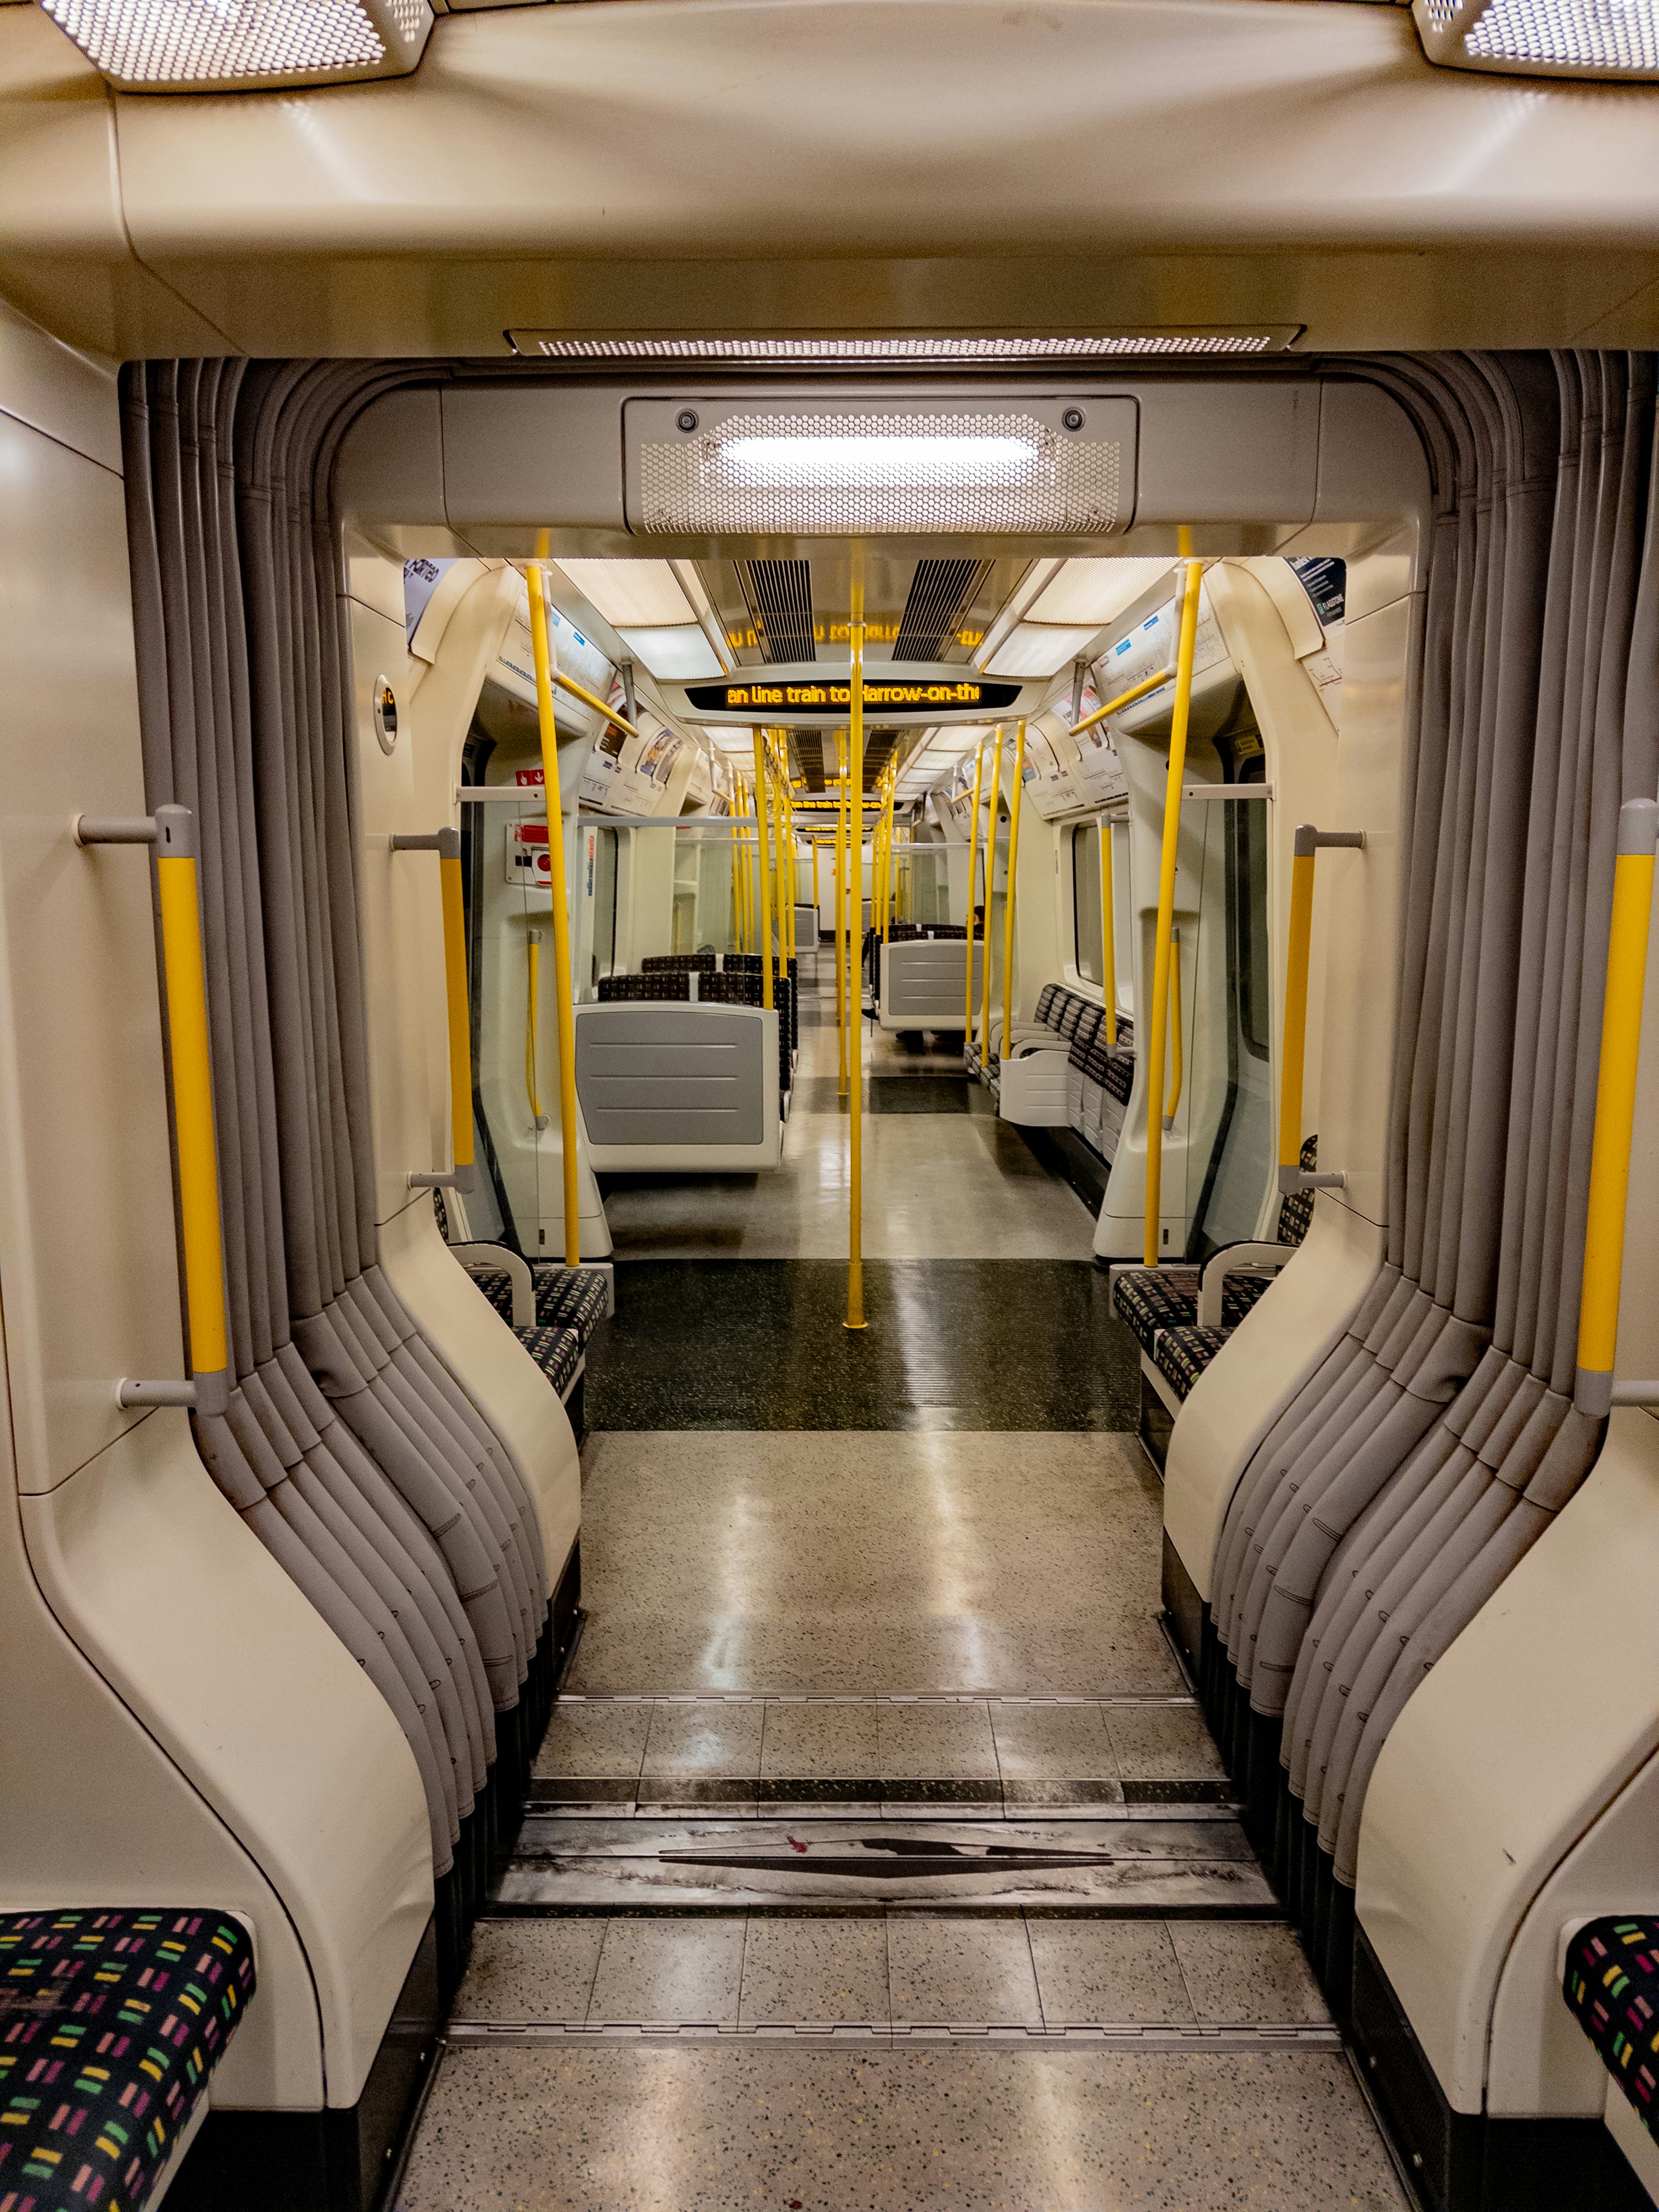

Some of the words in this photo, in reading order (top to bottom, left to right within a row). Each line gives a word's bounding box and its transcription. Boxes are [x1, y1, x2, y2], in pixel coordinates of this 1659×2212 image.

[727, 689, 748, 703] an
[752, 686, 783, 703] line
[786, 686, 826, 702] train
[830, 686, 850, 702] to
